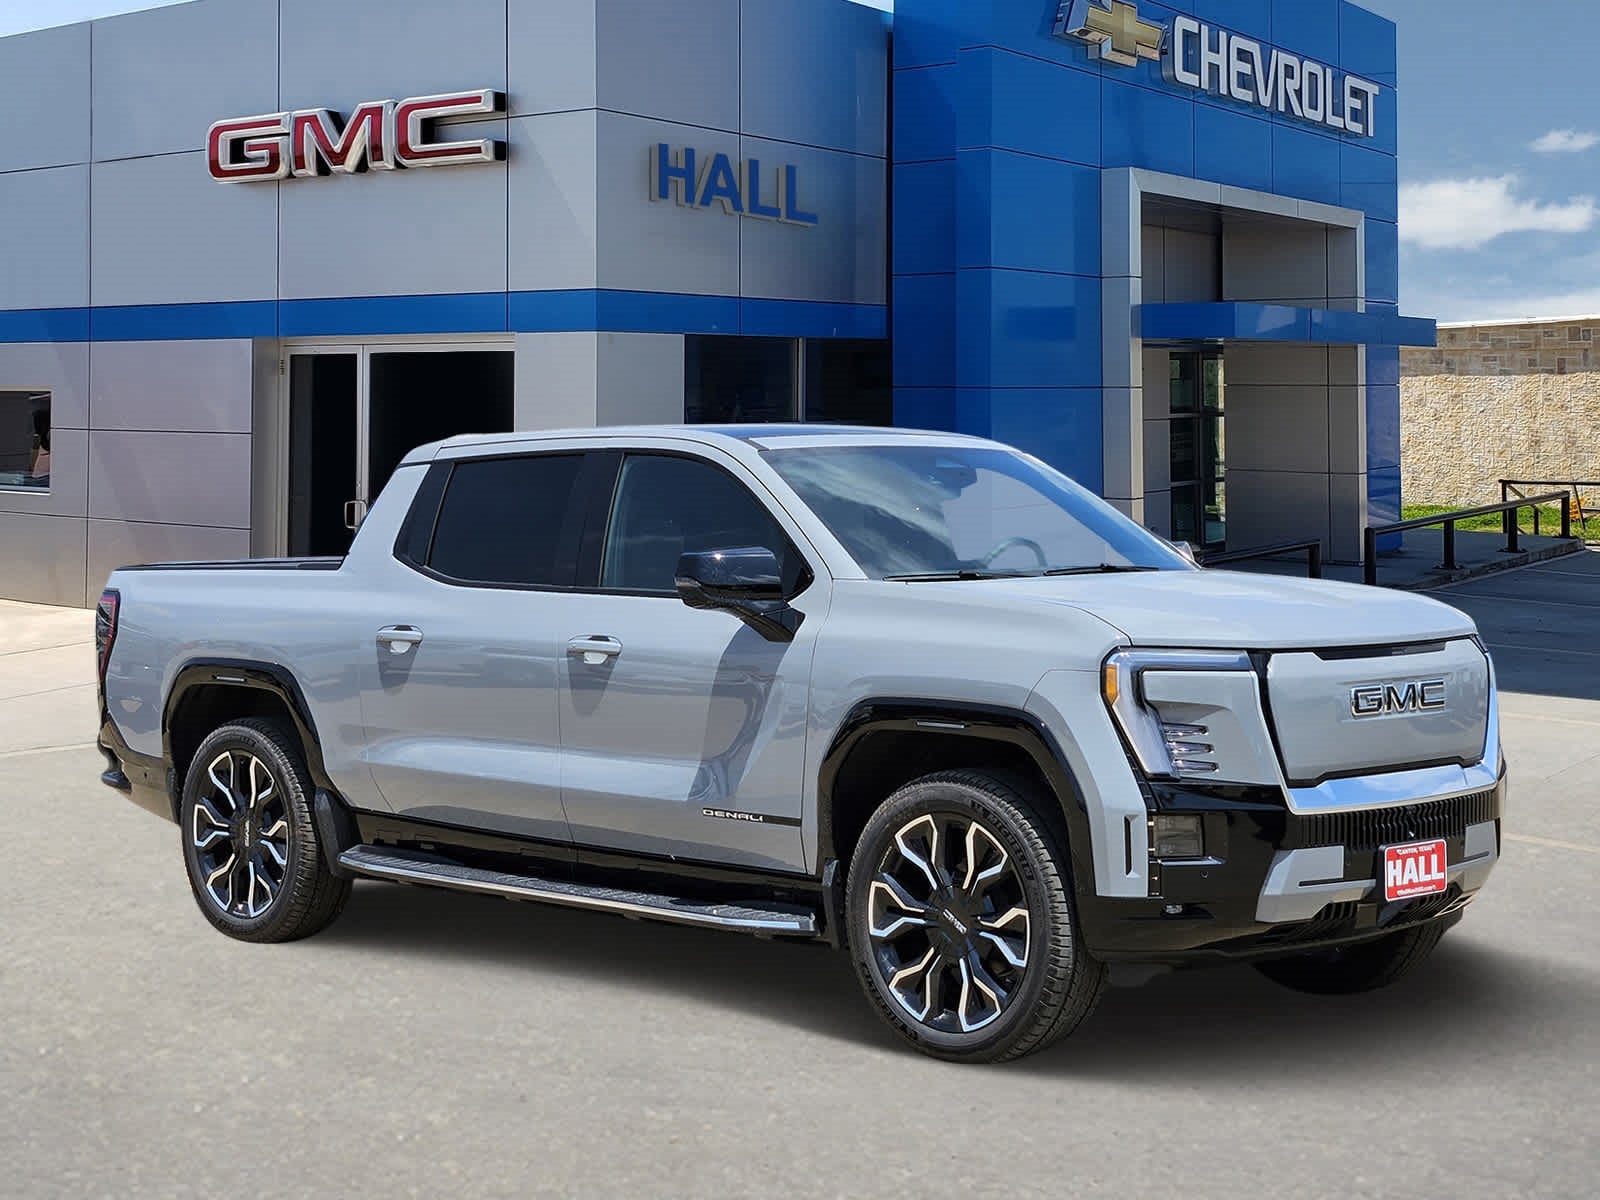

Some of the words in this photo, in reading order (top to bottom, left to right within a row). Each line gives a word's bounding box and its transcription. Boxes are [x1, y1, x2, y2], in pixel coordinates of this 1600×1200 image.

[1174, 15, 1379, 137] CHEVROLET
[207, 88, 503, 183] GMC
[653, 143, 819, 226] HALL
[1351, 679, 1446, 716] GMC
[702, 808, 764, 823] DENALI
[1387, 853, 1445, 888] HALL
